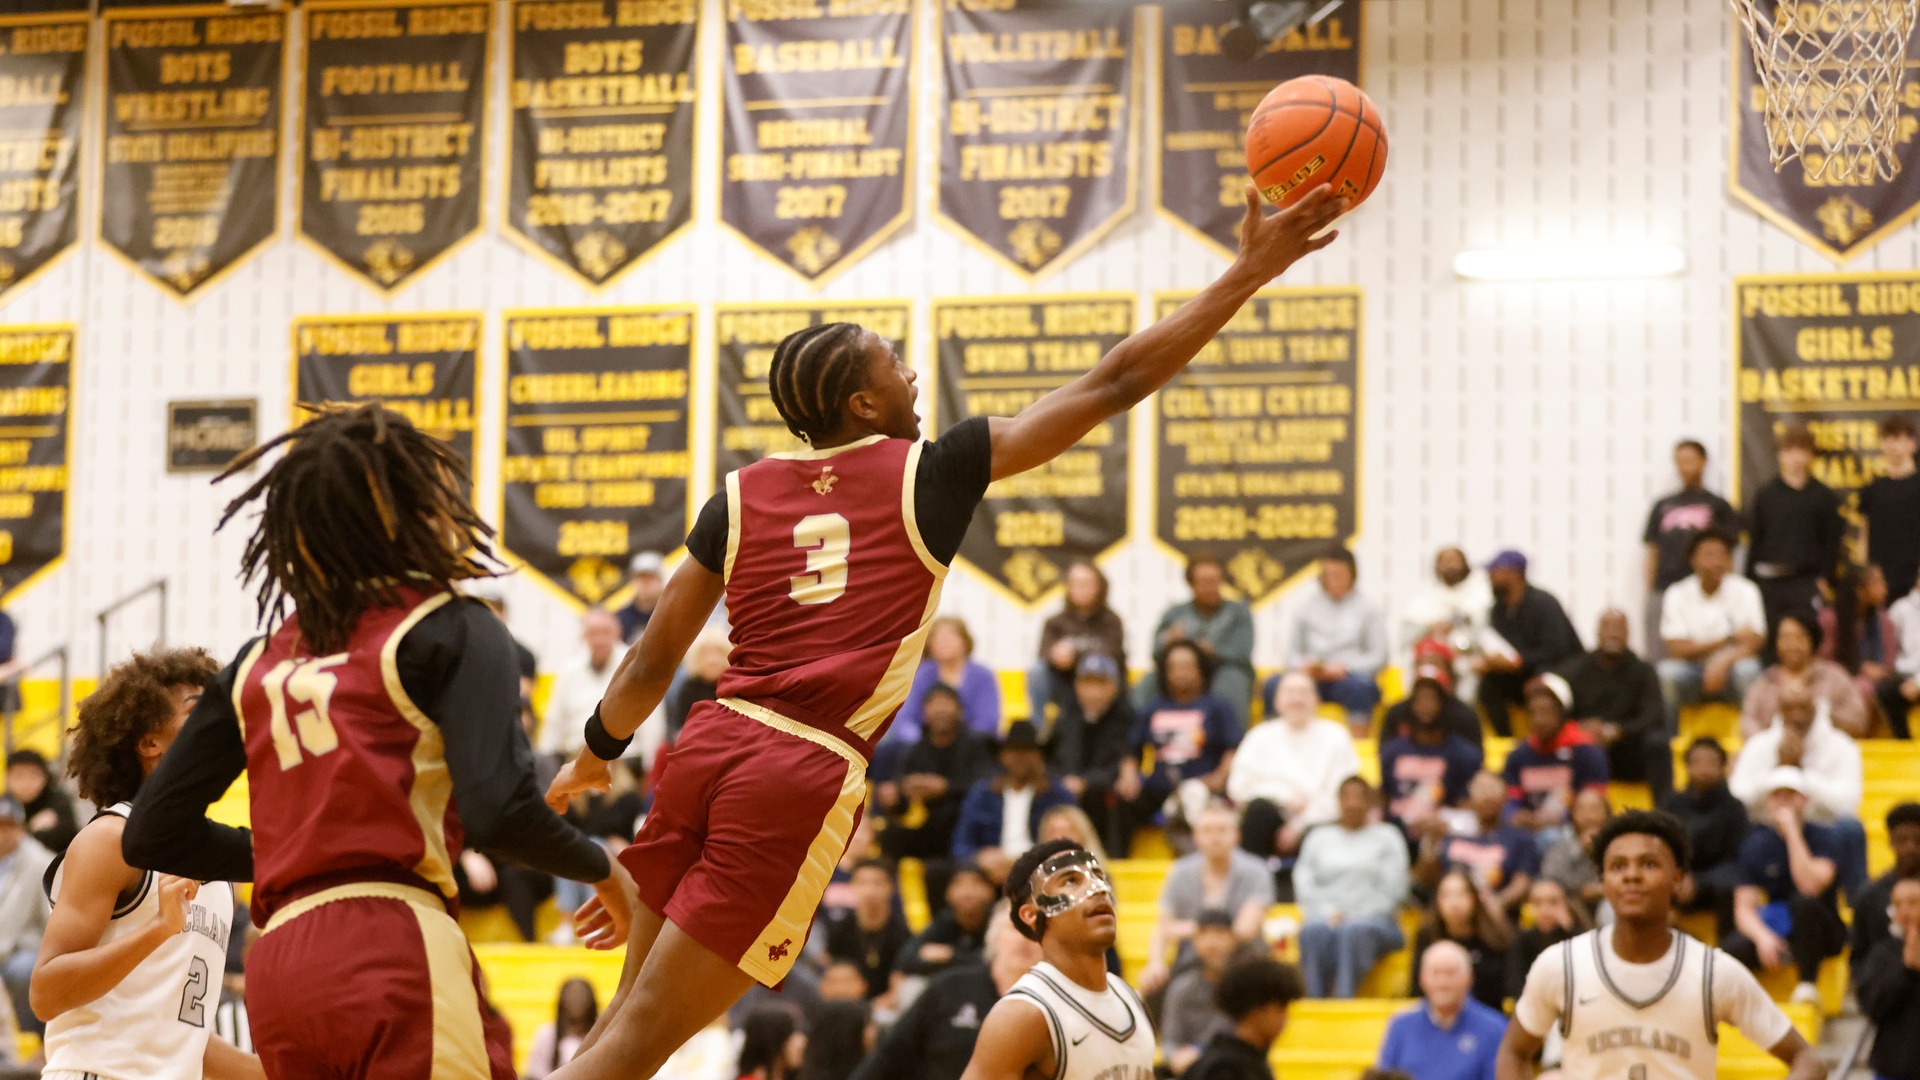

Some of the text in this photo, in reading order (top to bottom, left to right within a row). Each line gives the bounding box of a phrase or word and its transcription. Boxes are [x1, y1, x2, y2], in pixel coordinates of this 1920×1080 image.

[311, 11, 403, 40] FOSSIL
[518, 3, 611, 31] FOSSIL
[563, 39, 644, 74] BOYS
[734, 38, 904, 74] BASEBALL
[949, 28, 1126, 64] VOLLEYBALL
[160, 51, 231, 84] BOYS
[322, 62, 470, 96] FOOTBALL
[115, 88, 270, 121] WRESTLING
[511, 72, 697, 109] BASKETBALL
[951, 94, 1126, 136] BI-DISTRICT
[312, 123, 475, 161] BI-DISTRICT
[539, 123, 668, 154] BI-DISTRICT
[534, 155, 668, 189] FINALISTS
[727, 148, 902, 182] SEMI-FINALIST
[960, 140, 1113, 181] FINALISTS
[321, 165, 462, 201] FINALISTS
[775, 184, 848, 219] 2017
[998, 185, 1072, 220] 2017
[1742, 284, 1851, 318] FOSSIL
[511, 319, 606, 350] FOSSIL
[938, 308, 1040, 340] FOSSIL
[1043, 304, 1129, 336] RIDGE
[963, 341, 1101, 374] SWIM TEAM
[1796, 325, 1894, 362] GIRLS
[348, 361, 435, 396] GIRLS
[510, 368, 687, 404] CHEERLEADING
[787, 512, 850, 606] 3
[261, 651, 350, 772] 15
[178, 955, 208, 1028] 2
